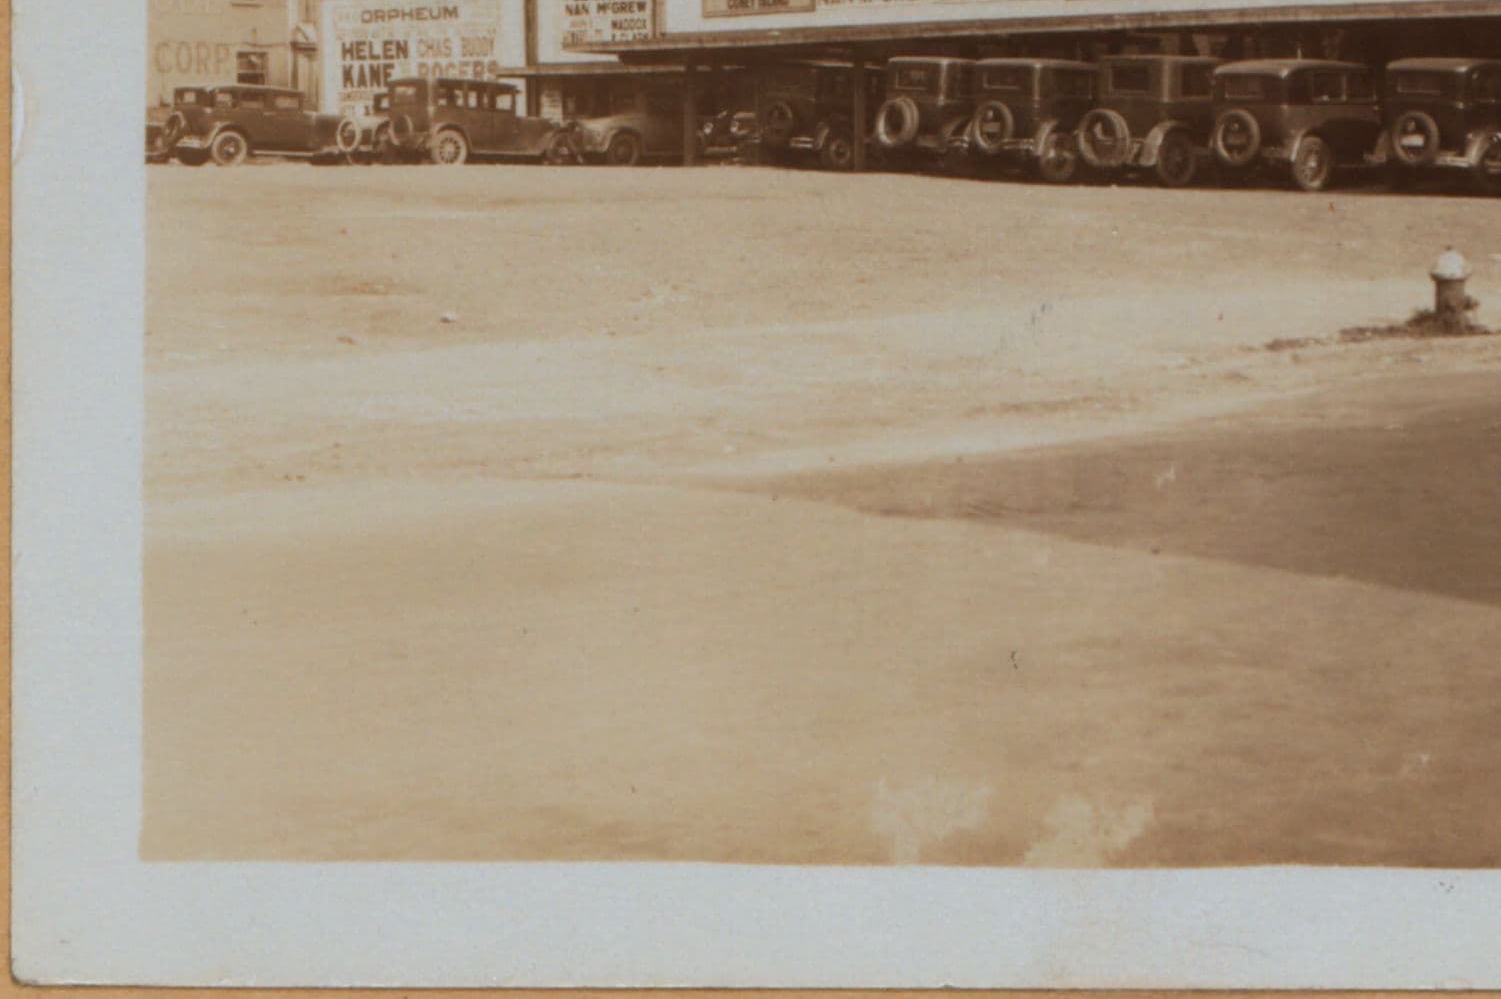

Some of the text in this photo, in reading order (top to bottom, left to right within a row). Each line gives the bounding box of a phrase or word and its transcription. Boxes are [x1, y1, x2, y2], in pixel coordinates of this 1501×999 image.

[361, 5, 459, 23] ORPHEUM
[565, 4, 590, 16] NAN
[341, 40, 408, 61] HELEN
[342, 62, 395, 89] KANE
